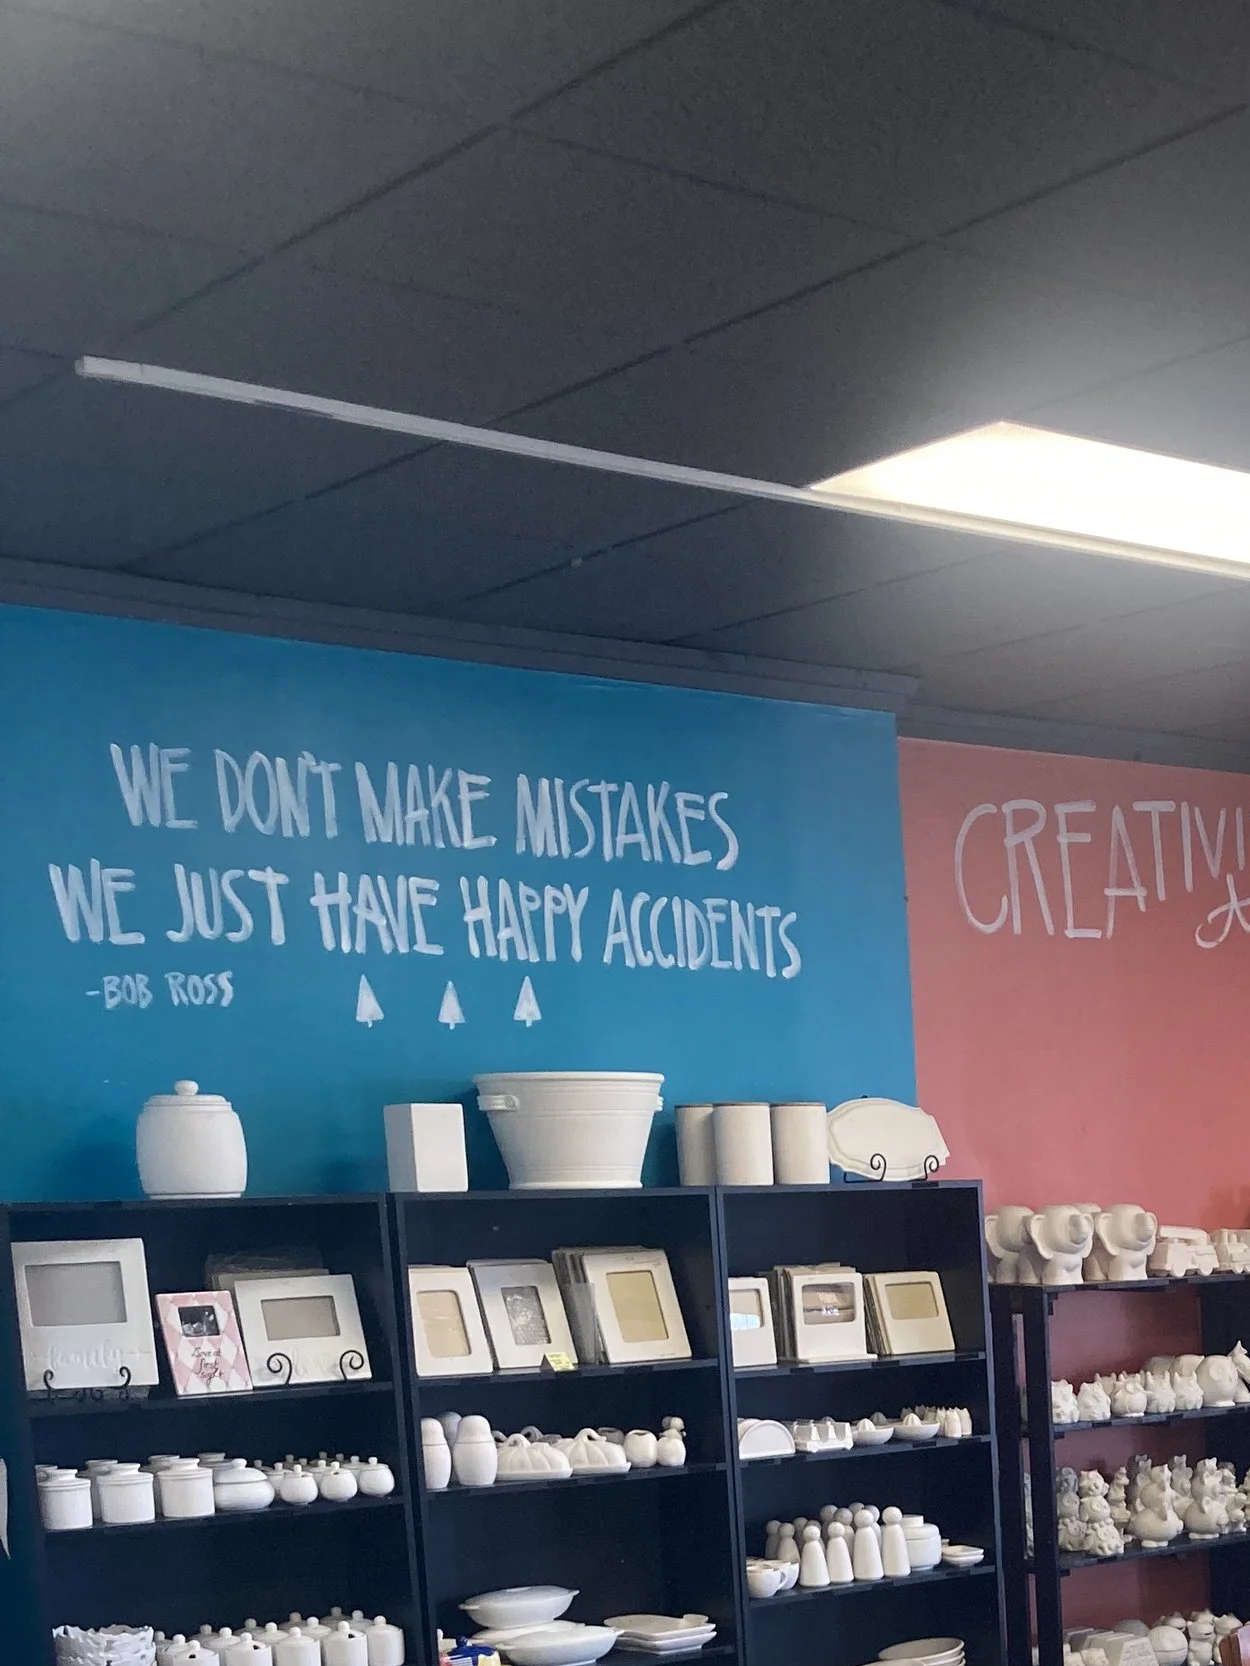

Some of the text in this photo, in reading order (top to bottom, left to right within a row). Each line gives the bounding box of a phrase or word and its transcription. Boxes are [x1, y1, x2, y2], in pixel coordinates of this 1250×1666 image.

[109, 742, 740, 871] WE DON'T MAKE MISTAKES
[48, 857, 802, 980] WE JUST HAVE HAPPY ACCIDENTS
[164, 970, 234, 1008] ROSS
